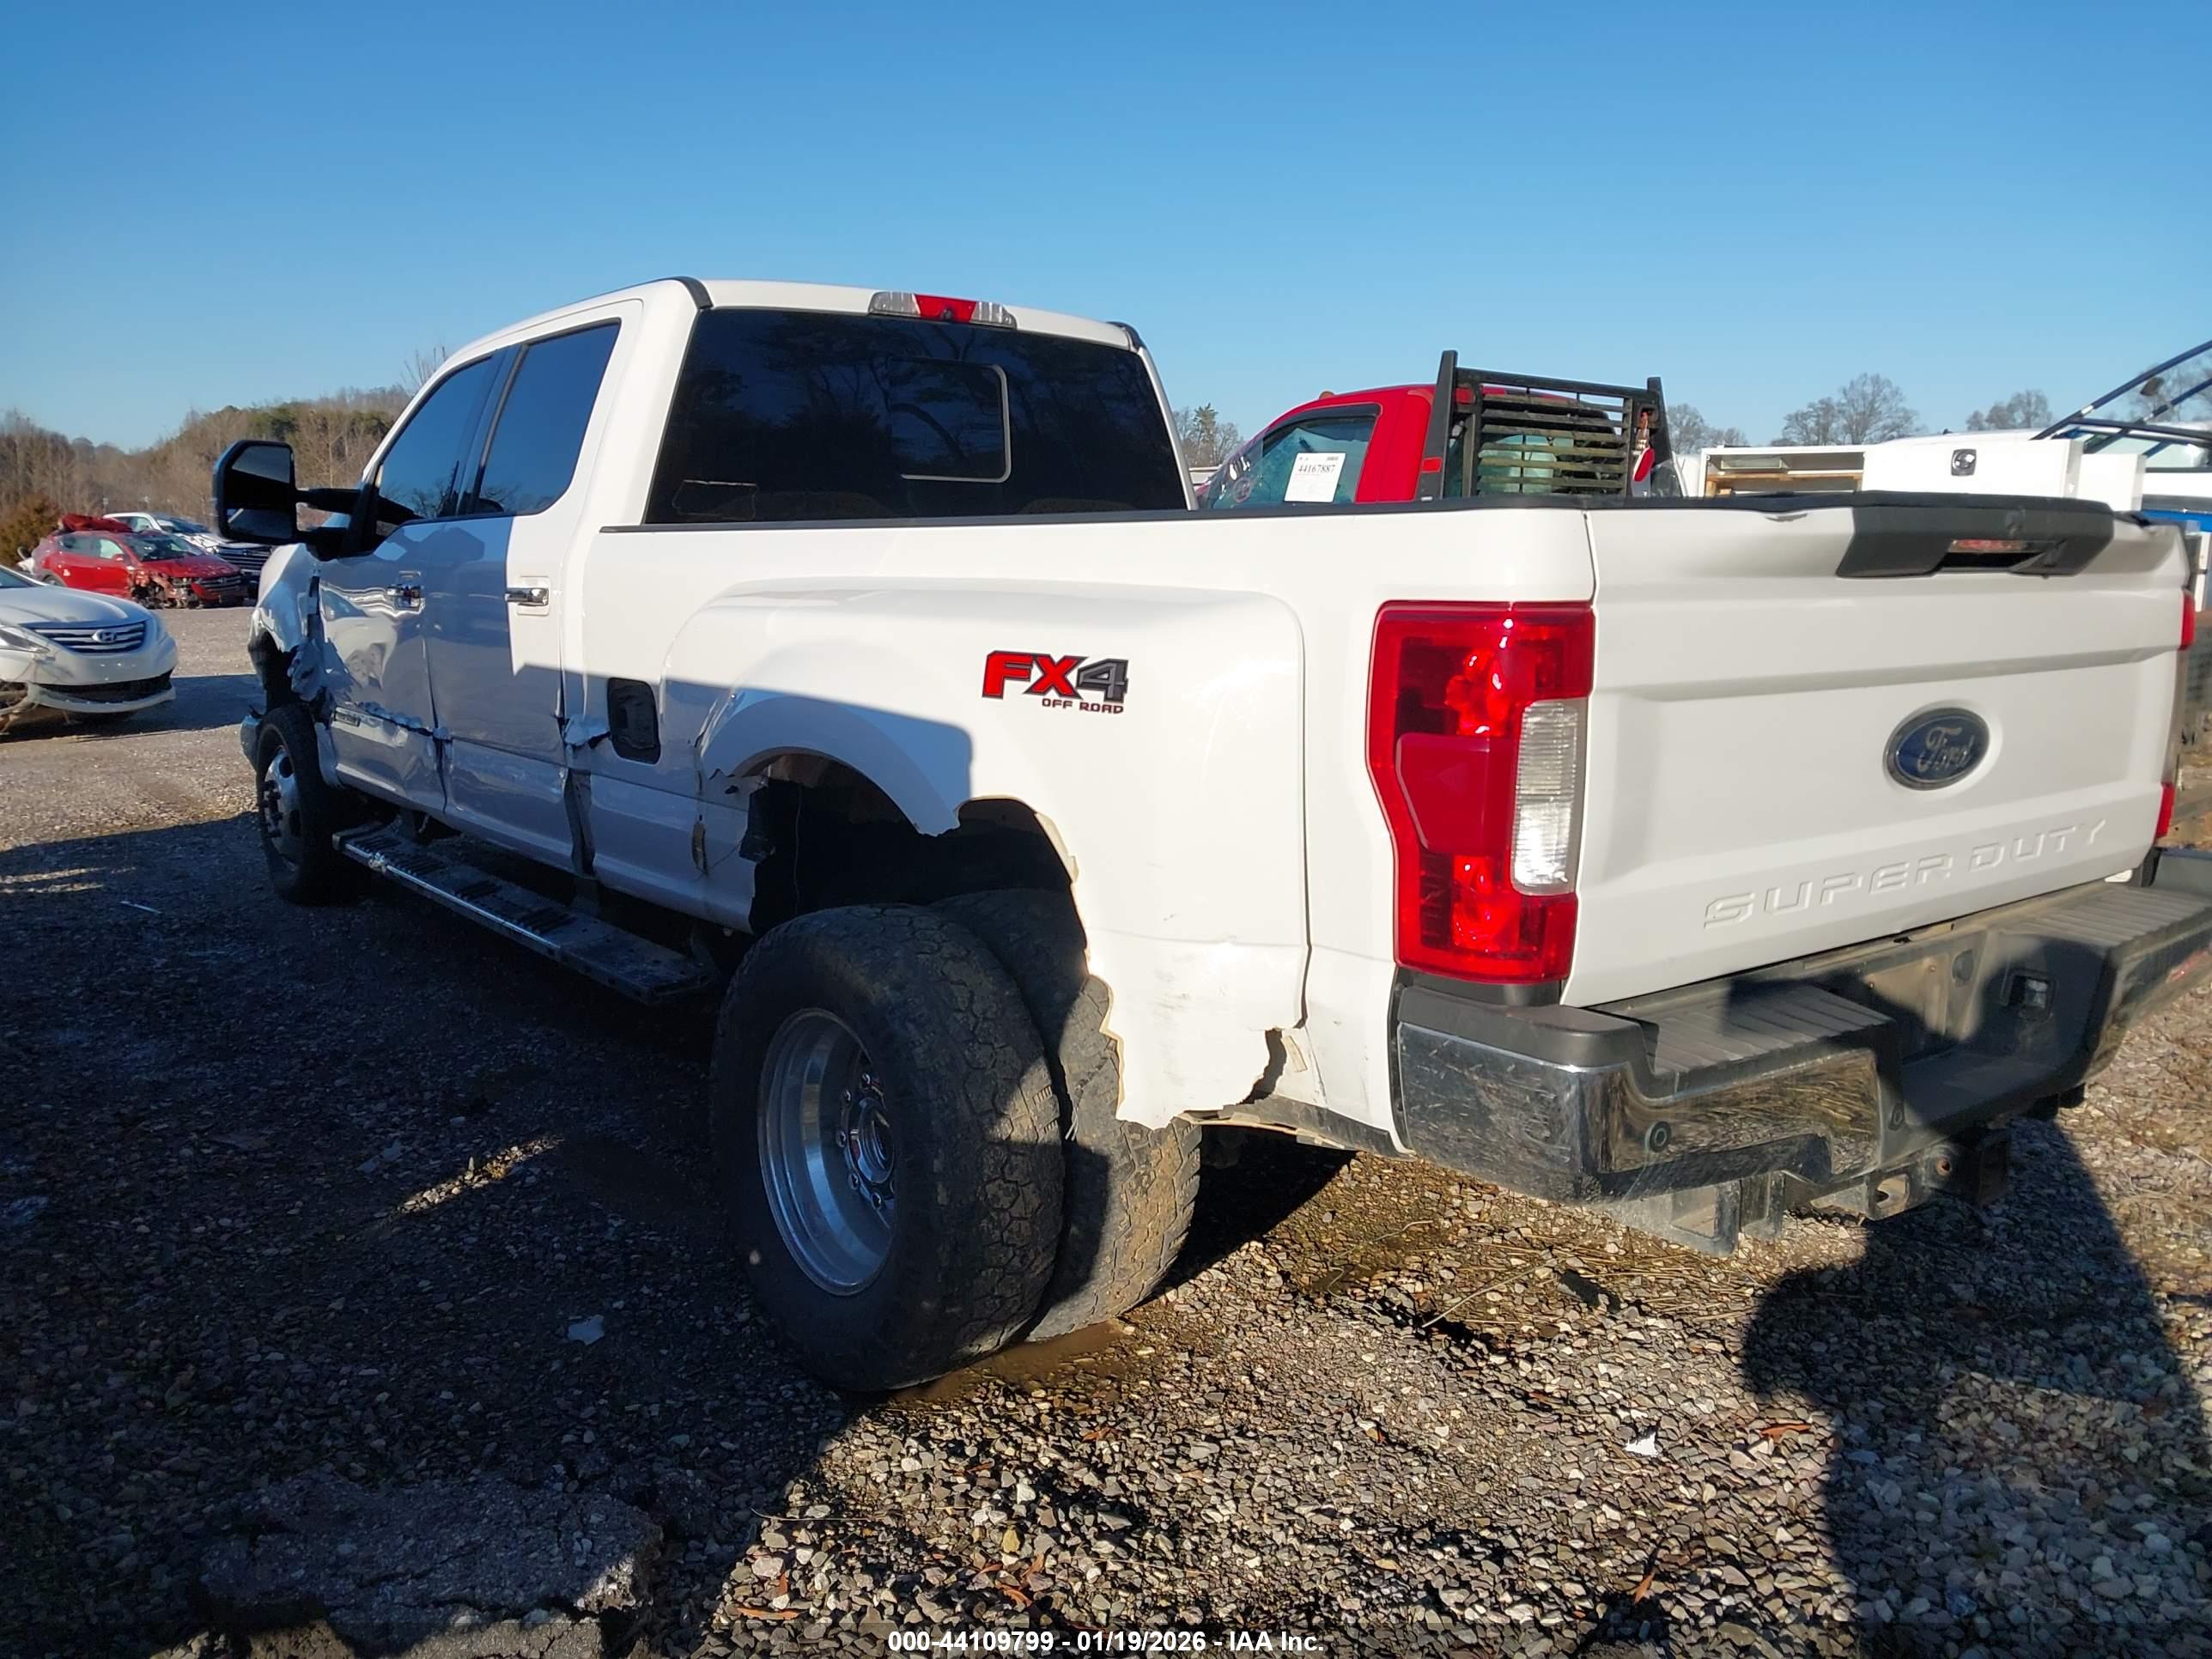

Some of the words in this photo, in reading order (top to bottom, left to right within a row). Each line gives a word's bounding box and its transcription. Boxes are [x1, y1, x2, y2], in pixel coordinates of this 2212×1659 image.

[1297, 464, 1336, 474] 44167887
[981, 650, 1128, 704] FX4
[1042, 698, 1073, 709] OFF
[1079, 702, 1124, 714] ROAD
[1917, 726, 1975, 773] Ford
[1704, 854, 1954, 929] SUPER
[1970, 818, 2106, 873] DUTY
